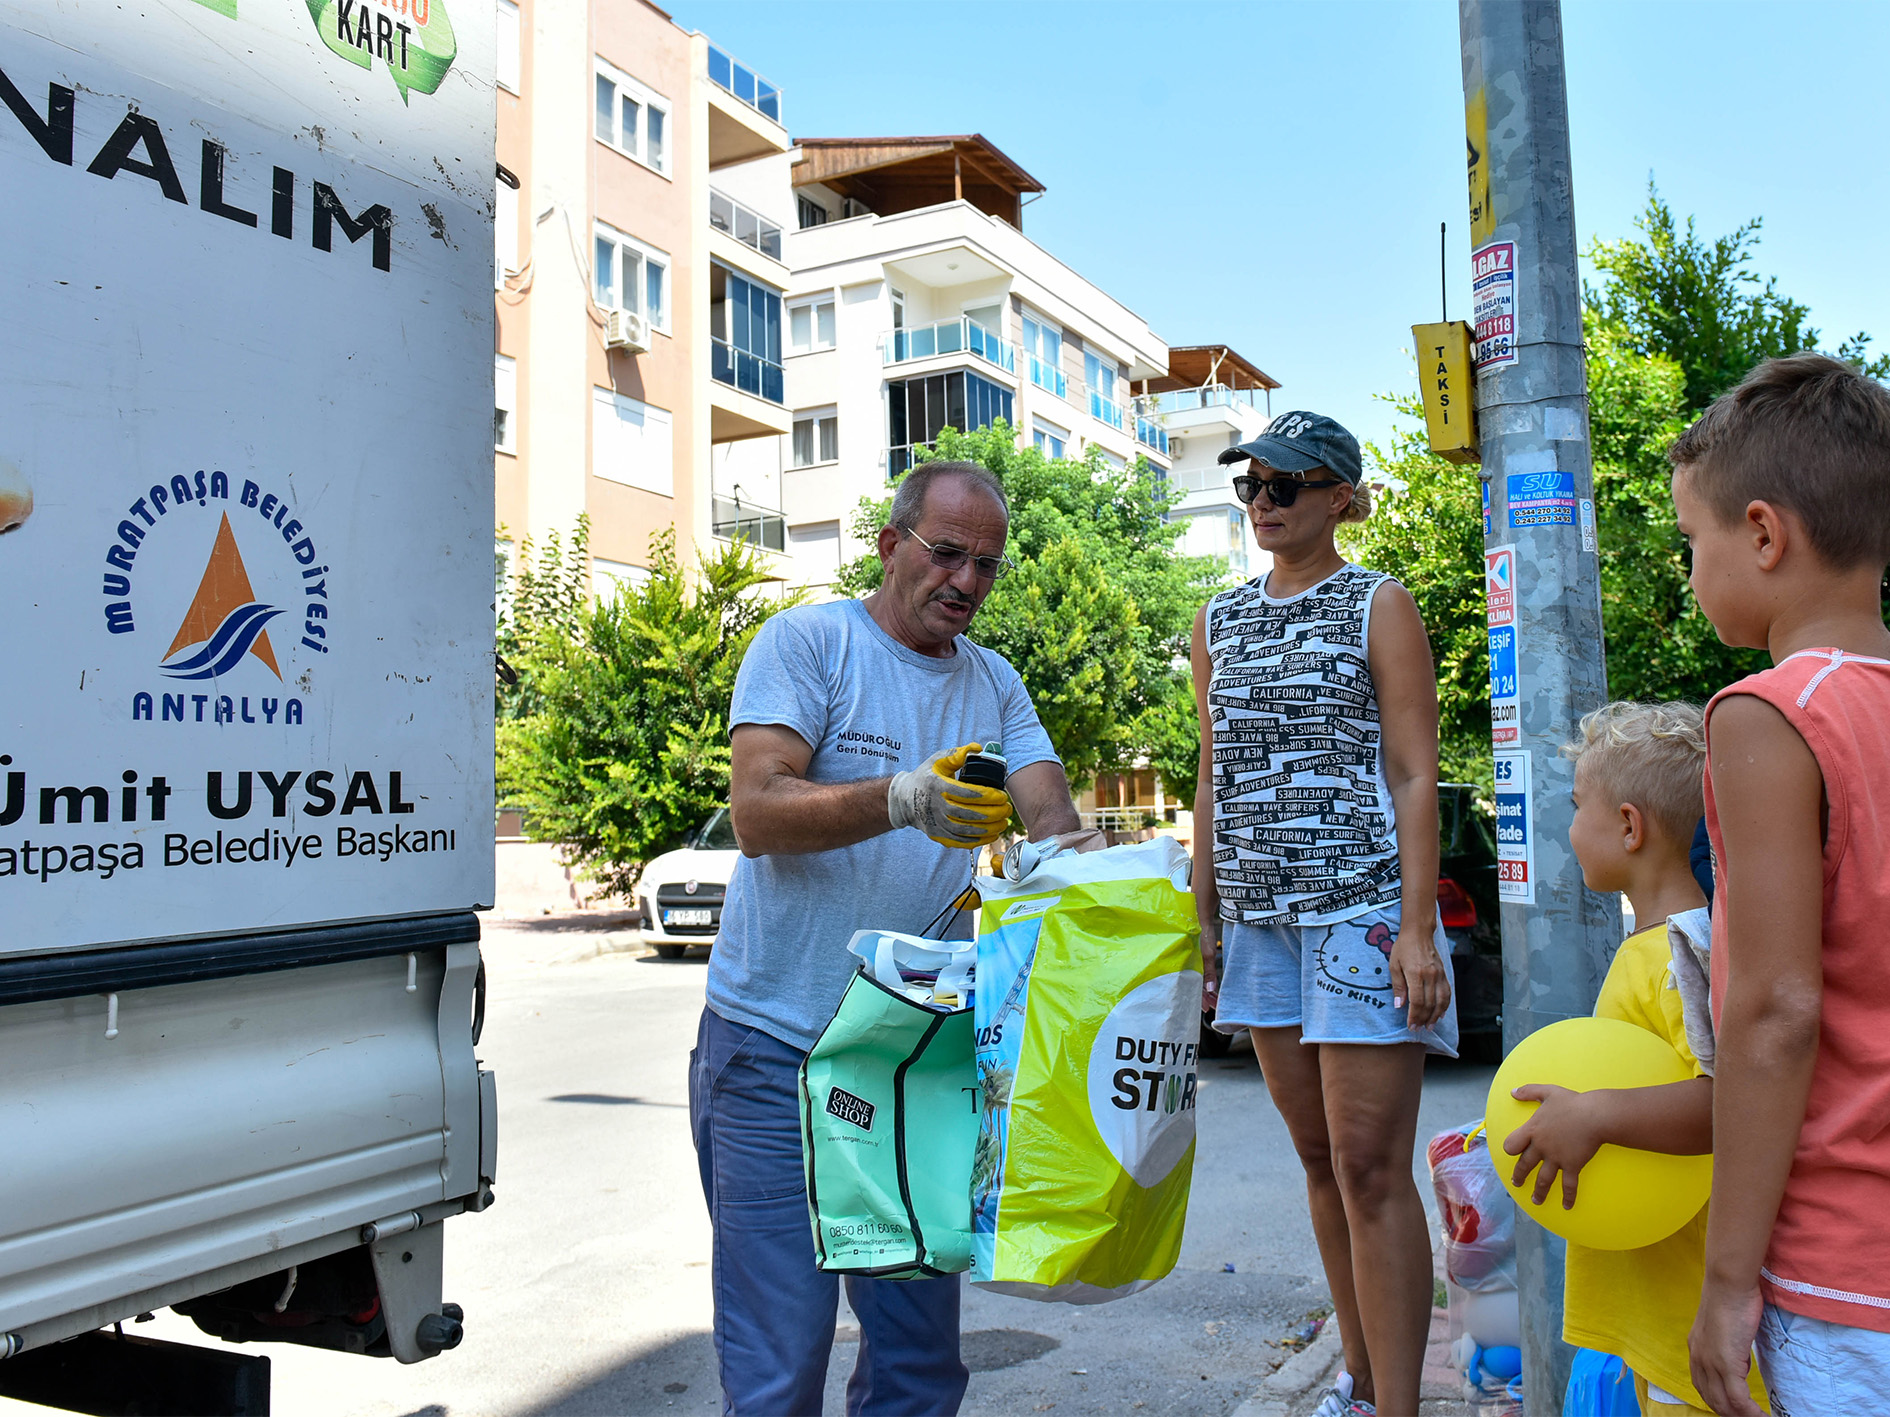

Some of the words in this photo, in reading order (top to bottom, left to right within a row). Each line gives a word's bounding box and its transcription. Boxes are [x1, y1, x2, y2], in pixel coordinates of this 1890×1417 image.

[338, 0, 411, 70] KART
[1435, 346, 1450, 425] TAKSİ
[1521, 473, 1562, 492] SU
[1515, 508, 1536, 517] 0.544
[1537, 507, 1552, 515] 270
[101, 470, 230, 635] MURATPAŞA
[239, 478, 330, 654] BELEDİYESİ
[1248, 640, 1301, 660] ADVENTURES
[1218, 673, 1273, 689] ADVENTURES
[1327, 672, 1348, 685] NEW
[1502, 674, 1514, 694] 24
[1252, 687, 1313, 700] CALIFORNIA
[132, 691, 303, 726] ANTALYA
[1216, 696, 1247, 708] SURFING
[1249, 701, 1270, 711] WAVE
[1272, 704, 1285, 713] BIG
[1343, 707, 1364, 718] WAVE
[1232, 720, 1276, 729] CALIFORNIA
[1298, 724, 1334, 734] SUMMER
[837, 730, 902, 751] MÜDÜROĞLU
[1240, 732, 1263, 742] WAVE
[1265, 733, 1279, 743] BIG
[1310, 739, 1333, 749] WAVE
[836, 743, 858, 755] Geri
[860, 746, 900, 763] Dönüşüm
[1243, 747, 1263, 759] NEW
[1226, 760, 1267, 773] CALIFORNIA
[1494, 760, 1512, 780] ES
[1220, 786, 1238, 799] SURF
[1240, 773, 1291, 792] ADVENTURES
[206, 770, 415, 820] UYSAL
[1277, 788, 1335, 799] ADVENTURES
[1262, 803, 1283, 812] WAVE
[1285, 803, 1320, 812] SURFERS
[1325, 814, 1346, 824] NEW
[1255, 829, 1312, 843] CALIFORNIA
[163, 828, 322, 867] Belediye
[336, 824, 456, 861] Başkanı
[1345, 845, 1371, 855] WAVE
[1241, 860, 1277, 870] CALIFORNIA
[1246, 873, 1266, 884] WAVE
[1298, 867, 1335, 877] SUMMER
[1511, 863, 1524, 881] 89
[1267, 875, 1281, 885] BIG
[1308, 880, 1335, 891] WAVE
[1249, 888, 1268, 899] NEW
[1298, 896, 1331, 912] SUMMER
[1316, 978, 1343, 995] Hello
[1347, 989, 1387, 1009] Kitty
[1115, 1036, 1183, 1066] DUTY
[833, 1090, 871, 1115] ONLINE
[830, 1100, 869, 1126] SHOP
[829, 1225, 855, 1238] 0850
[856, 1224, 875, 1236] 811
